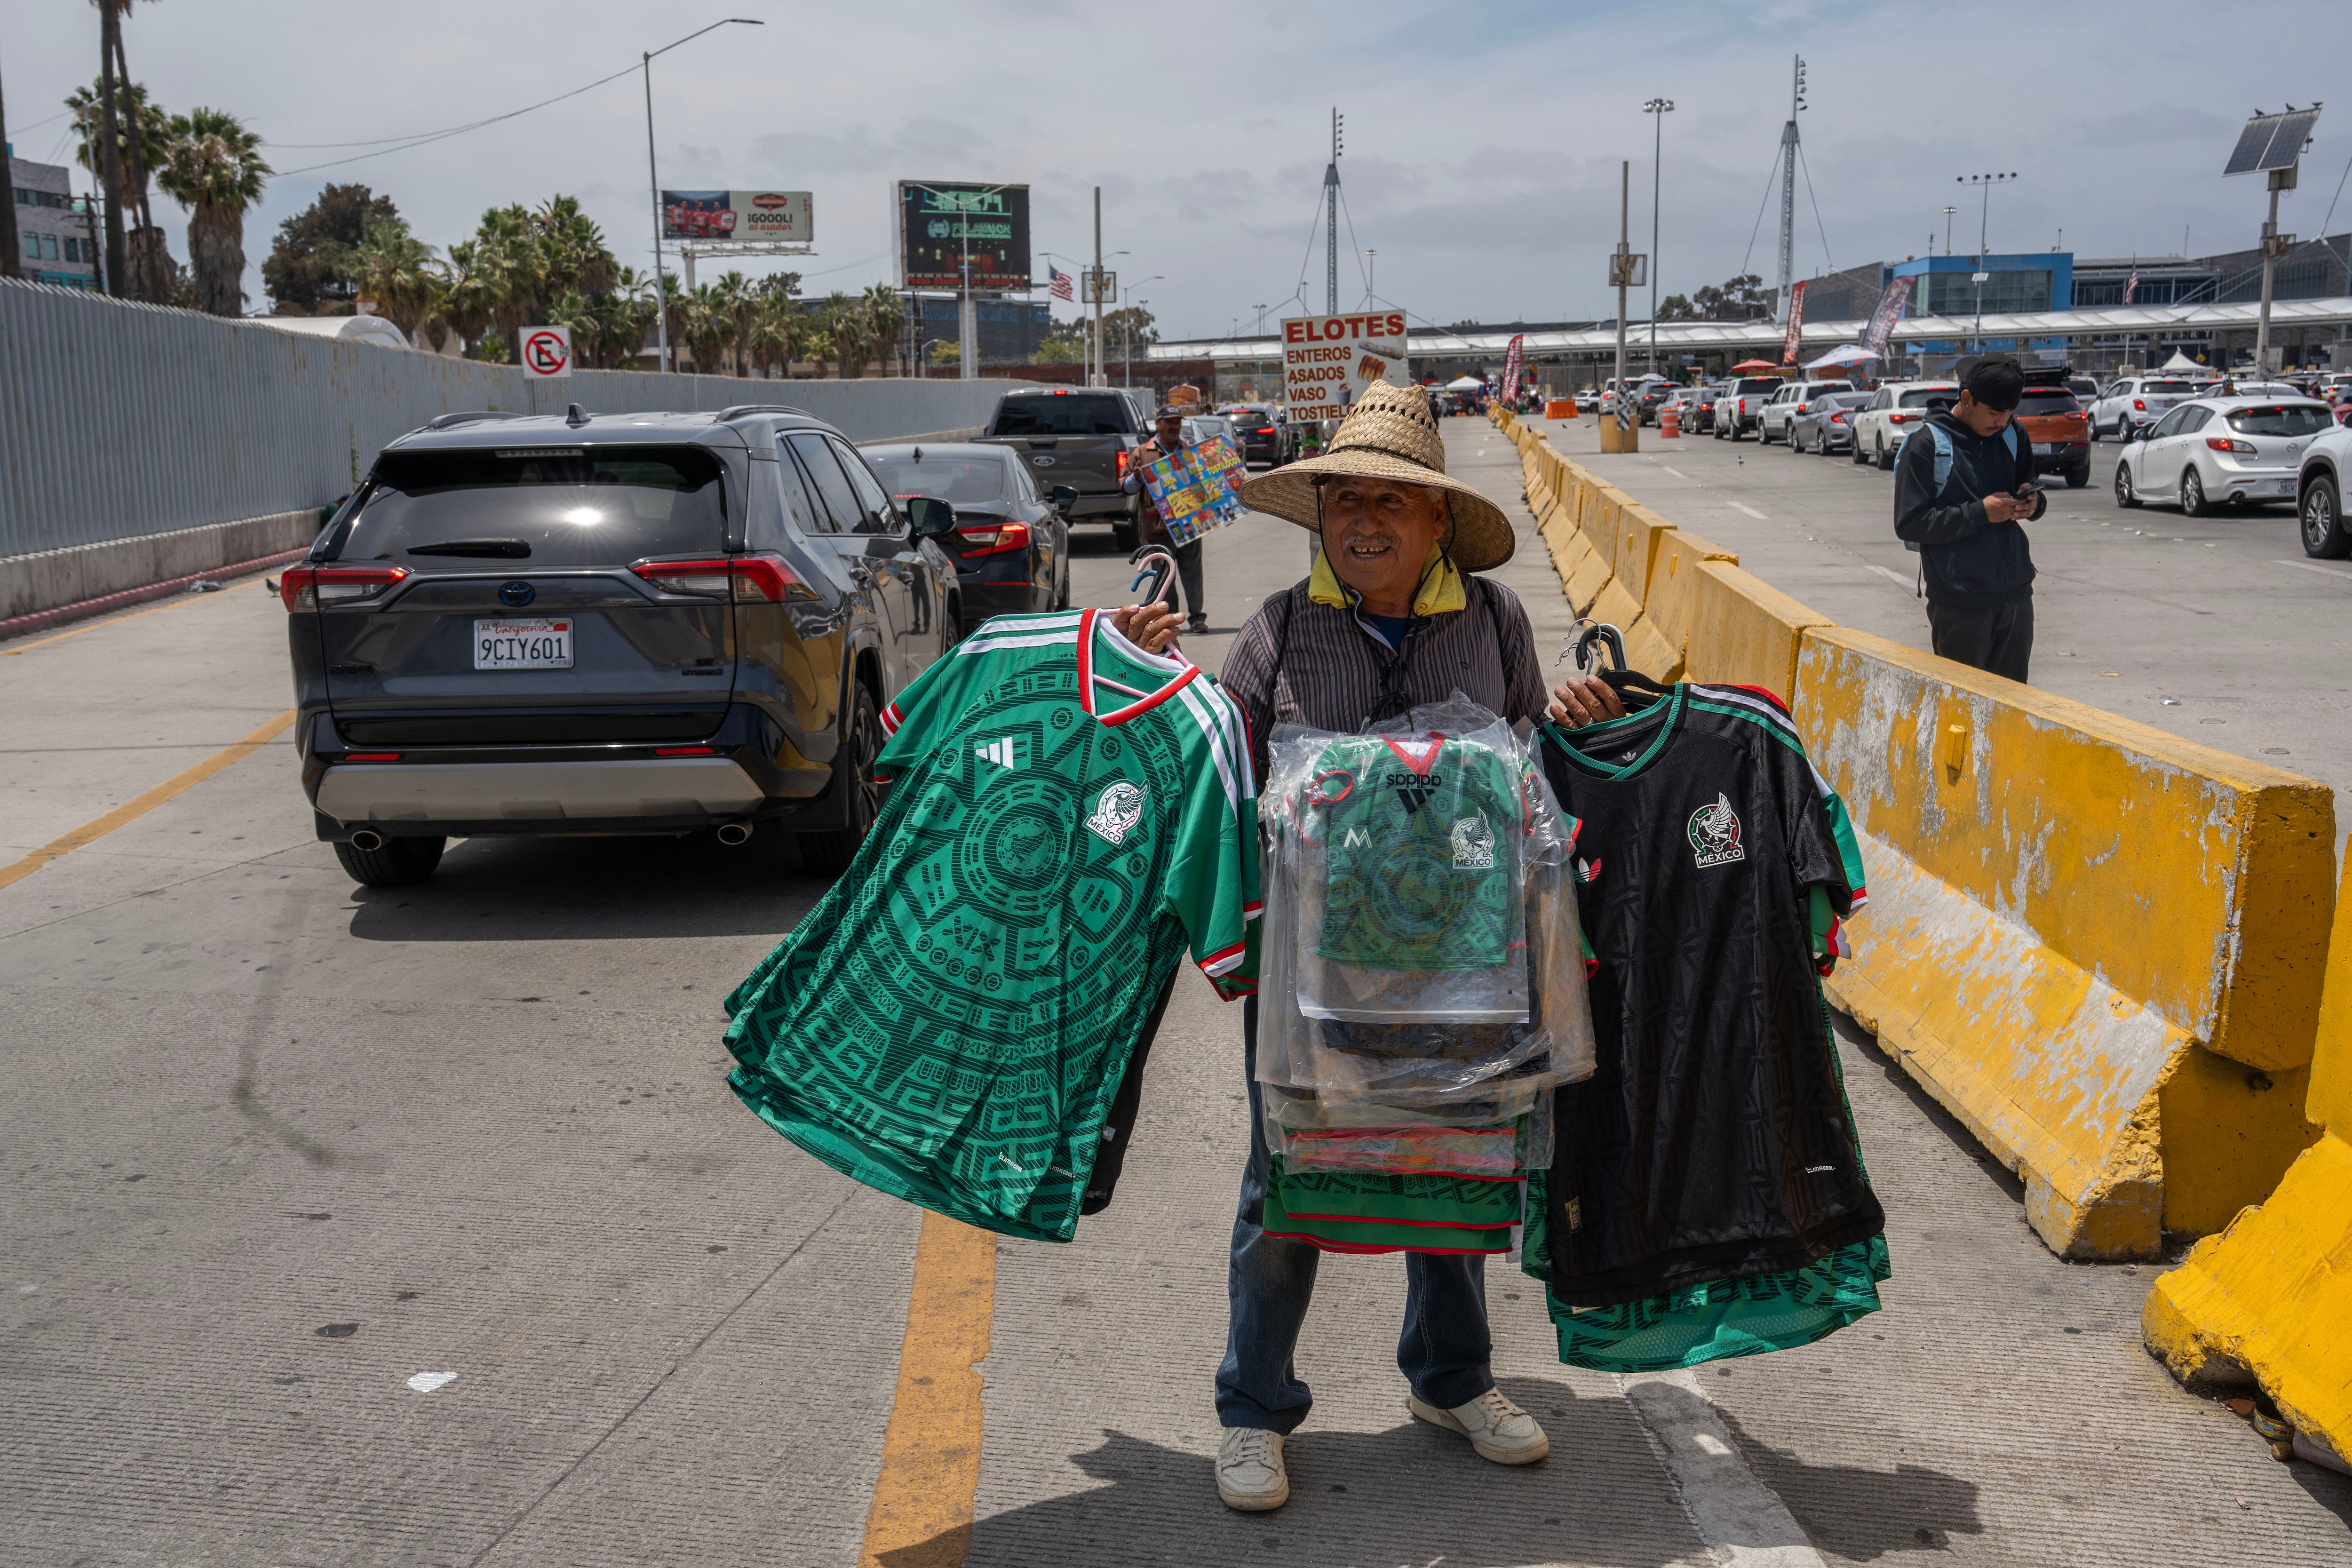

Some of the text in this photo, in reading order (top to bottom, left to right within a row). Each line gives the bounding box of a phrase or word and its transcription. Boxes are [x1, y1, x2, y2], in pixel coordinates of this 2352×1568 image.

[748, 213, 793, 223] ¡GOOOL!
[1286, 314, 1405, 343] ELOTES
[1287, 346, 1351, 364] ENTEROS
[1288, 366, 1345, 383] ASADOS
[1288, 386, 1327, 402] VASO
[1207, 456, 1241, 475] TOSTILOCOS
[495, 626, 548, 637] California
[481, 637, 566, 660] 9CIY601
[1386, 773, 1442, 788] adidas
[1089, 819, 1120, 842] MÉXICO
[1456, 857, 1491, 866] MÉXICO
[1698, 848, 1741, 865] MÉXICO
